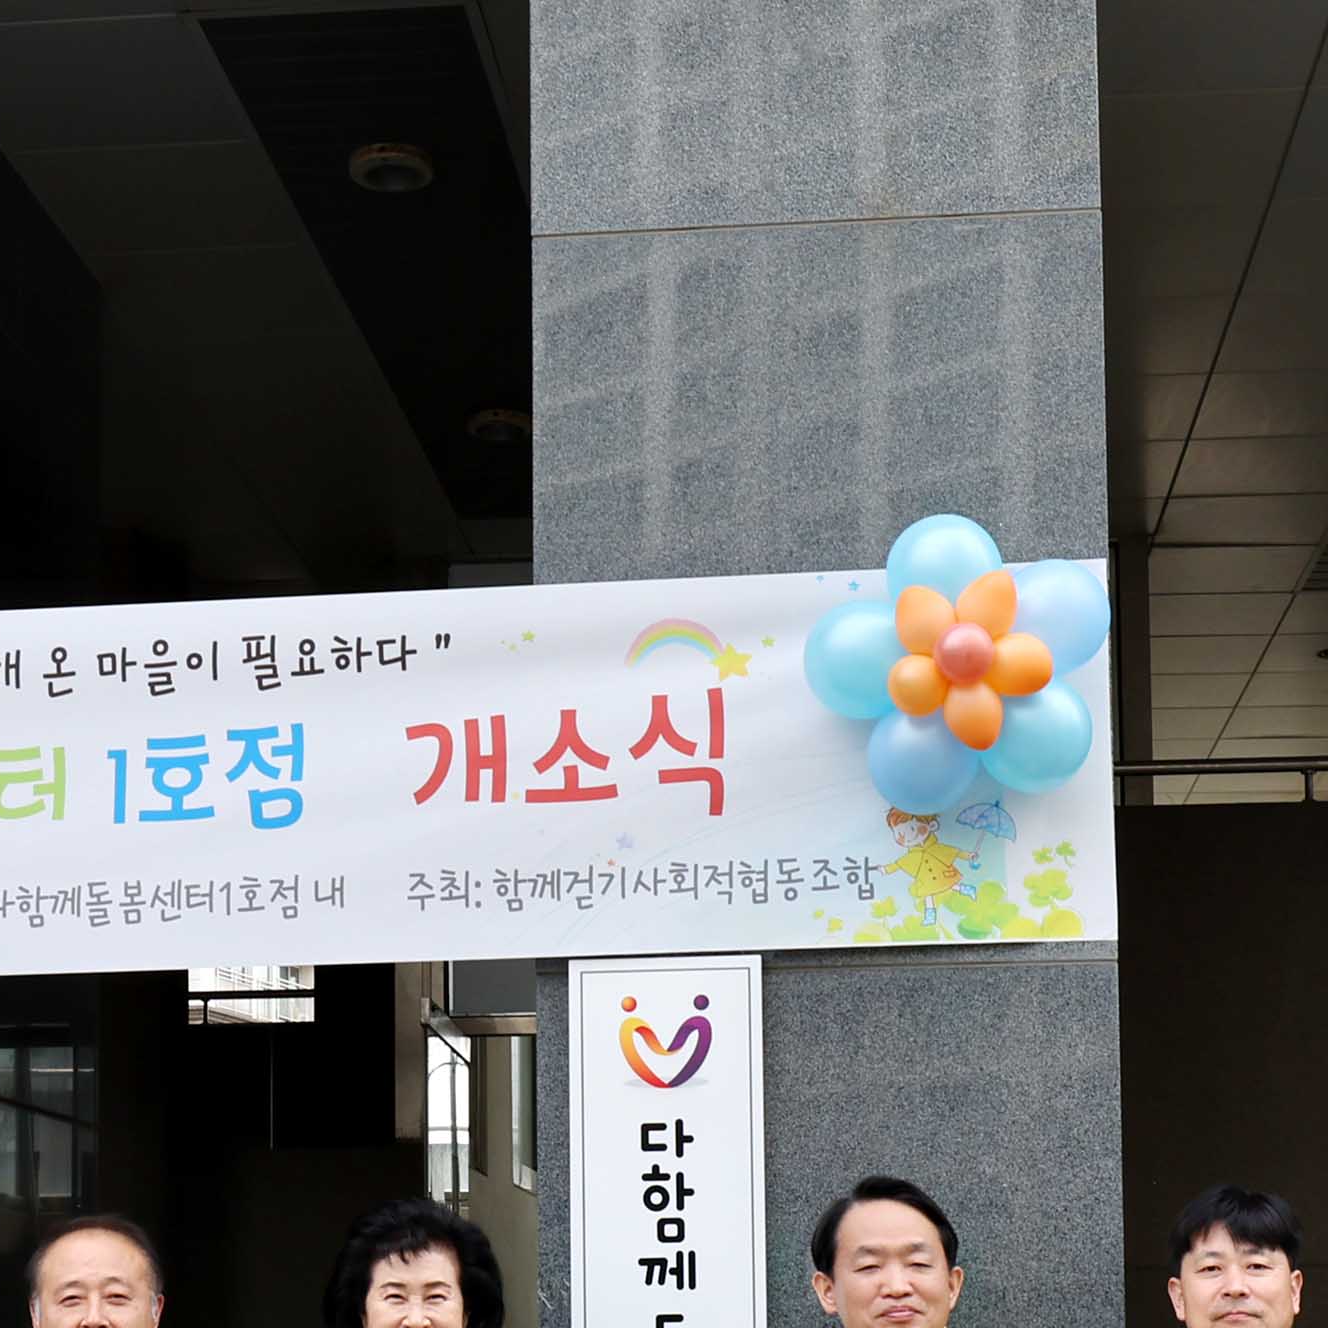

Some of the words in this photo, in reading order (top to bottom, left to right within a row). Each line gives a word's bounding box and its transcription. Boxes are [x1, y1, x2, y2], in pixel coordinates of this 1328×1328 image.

[42, 646, 77, 699] 온
[96, 638, 219, 697] 마을이
[106, 721, 305, 831] 1호점
[406, 687, 726, 817] 개소식
[314, 875, 345, 909] 내
[407, 868, 482, 912] 주최:
[492, 855, 877, 913] 함께걷기사회적협동조합
